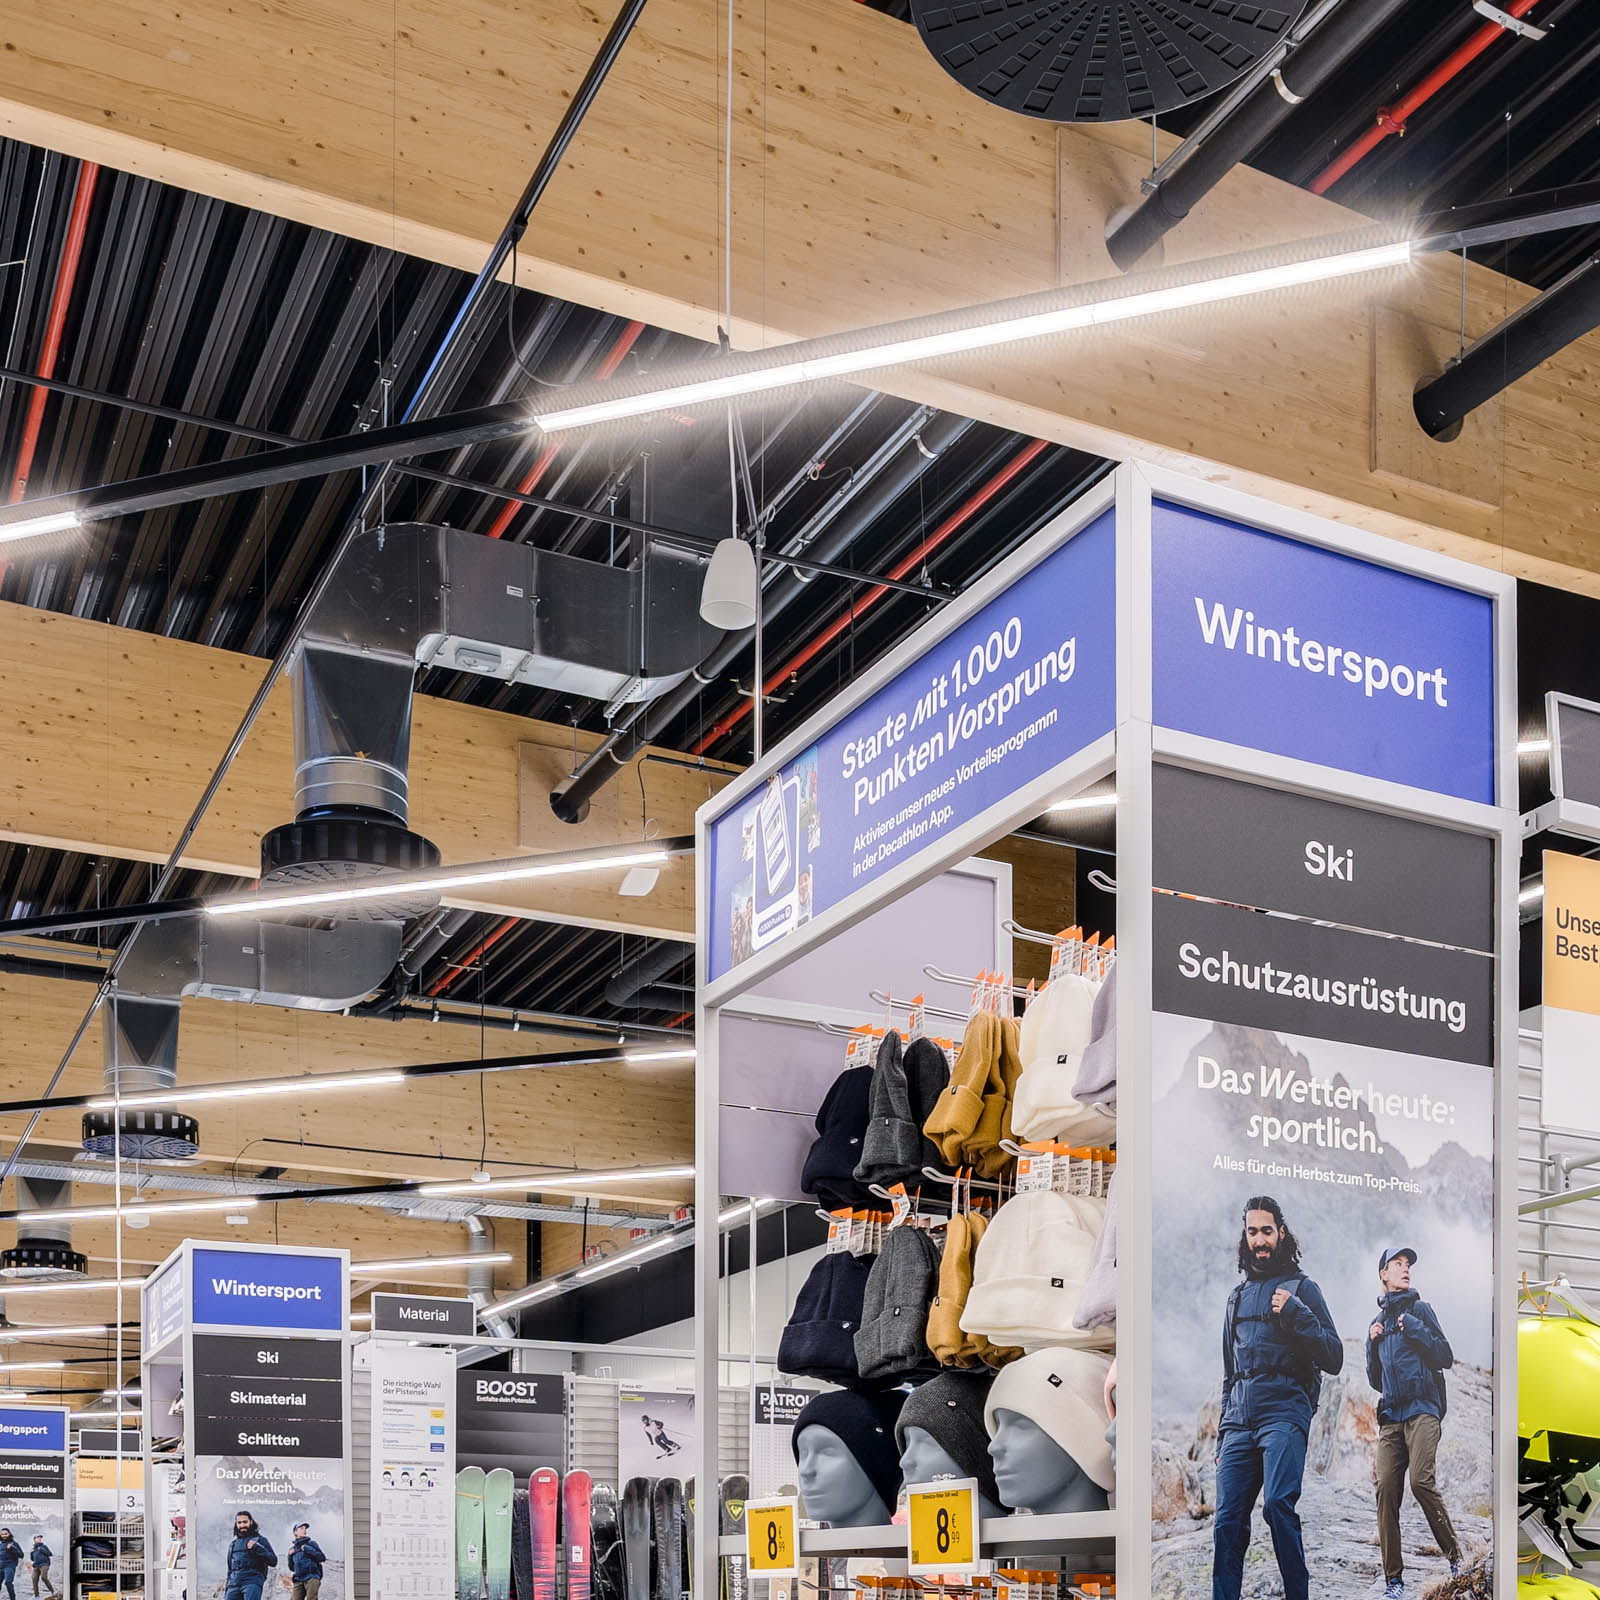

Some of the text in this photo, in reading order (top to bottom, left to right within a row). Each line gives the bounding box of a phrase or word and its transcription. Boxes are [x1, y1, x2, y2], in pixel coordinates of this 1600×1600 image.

[1194, 597, 1449, 708] Wintersport
[842, 712, 906, 779] Starte
[951, 616, 1022, 698] 1.000
[853, 637, 1076, 816] Punkten Vorsprung
[853, 708, 1058, 855] Aktiviere unser neues Vorteilsprogramm
[853, 804, 954, 879] in der Decathlon App.
[1304, 840, 1354, 882] Ski
[1177, 941, 1466, 1033] Schutzausrüstung
[1196, 1055, 1456, 1125] Das Wetter heute:
[1247, 1113, 1384, 1155] sportlich.
[1212, 1153, 1423, 1195] Alles für den Herbst zum Top-Preis.
[211, 1278, 322, 1302] Wintersport
[399, 1306, 449, 1322] Material
[256, 1350, 279, 1364] Ski
[229, 1390, 307, 1406] Skimaterial
[383, 1379, 441, 1389] Die richtige Wahl
[383, 1387, 428, 1396] der Pistenski
[476, 1379, 538, 1397] BOOST
[237, 1432, 300, 1446] Schlitten
[215, 1467, 241, 1480] Das
[241, 1468, 287, 1481] Wetter
[236, 1481, 296, 1494] sportlich.
[768, 1521, 778, 1560] 8
[937, 1508, 950, 1554] 8
